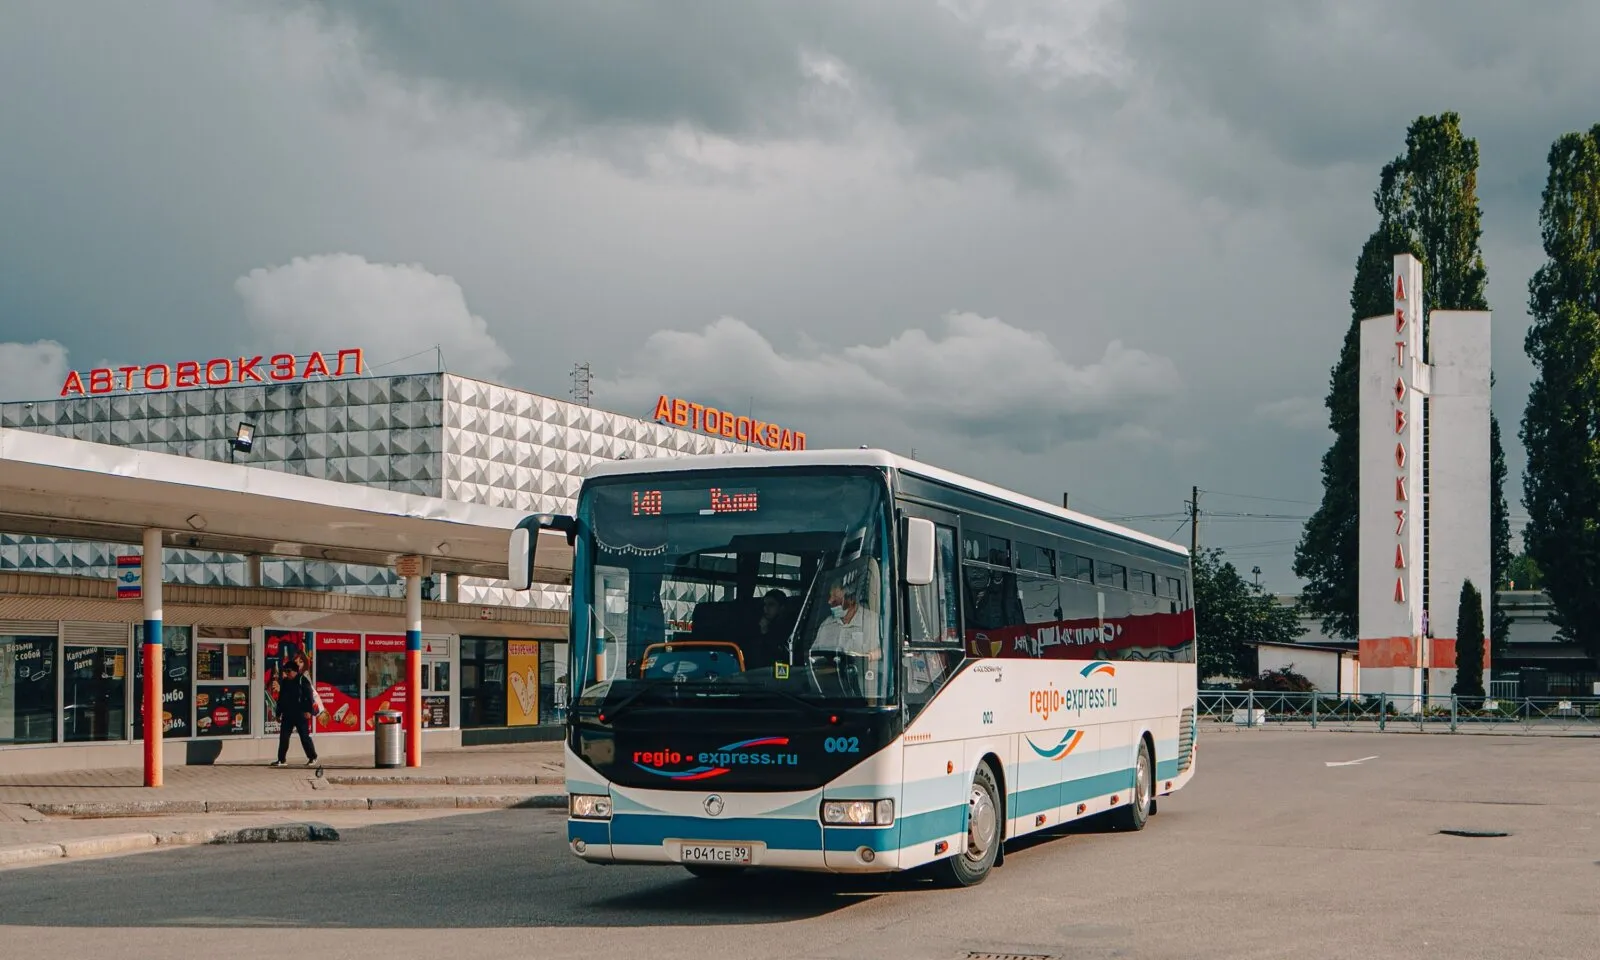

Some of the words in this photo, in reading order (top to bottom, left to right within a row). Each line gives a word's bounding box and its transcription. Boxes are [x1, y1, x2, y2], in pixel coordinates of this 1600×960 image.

[60, 347, 364, 397] АВТОВОКЗАЛ
[655, 395, 805, 451] АВТОВОКЗАЛ
[1394, 275, 1407, 603] АВТОВОКЗАЛ
[632, 490, 662, 516] 140
[6, 642, 33, 653] Возьми
[14, 653, 20, 661] с
[20, 649, 41, 660] собой
[74, 659, 93, 671] Латте
[982, 711, 994, 724] 002
[824, 736, 860, 753] 002
[734, 847, 747, 859] 39
